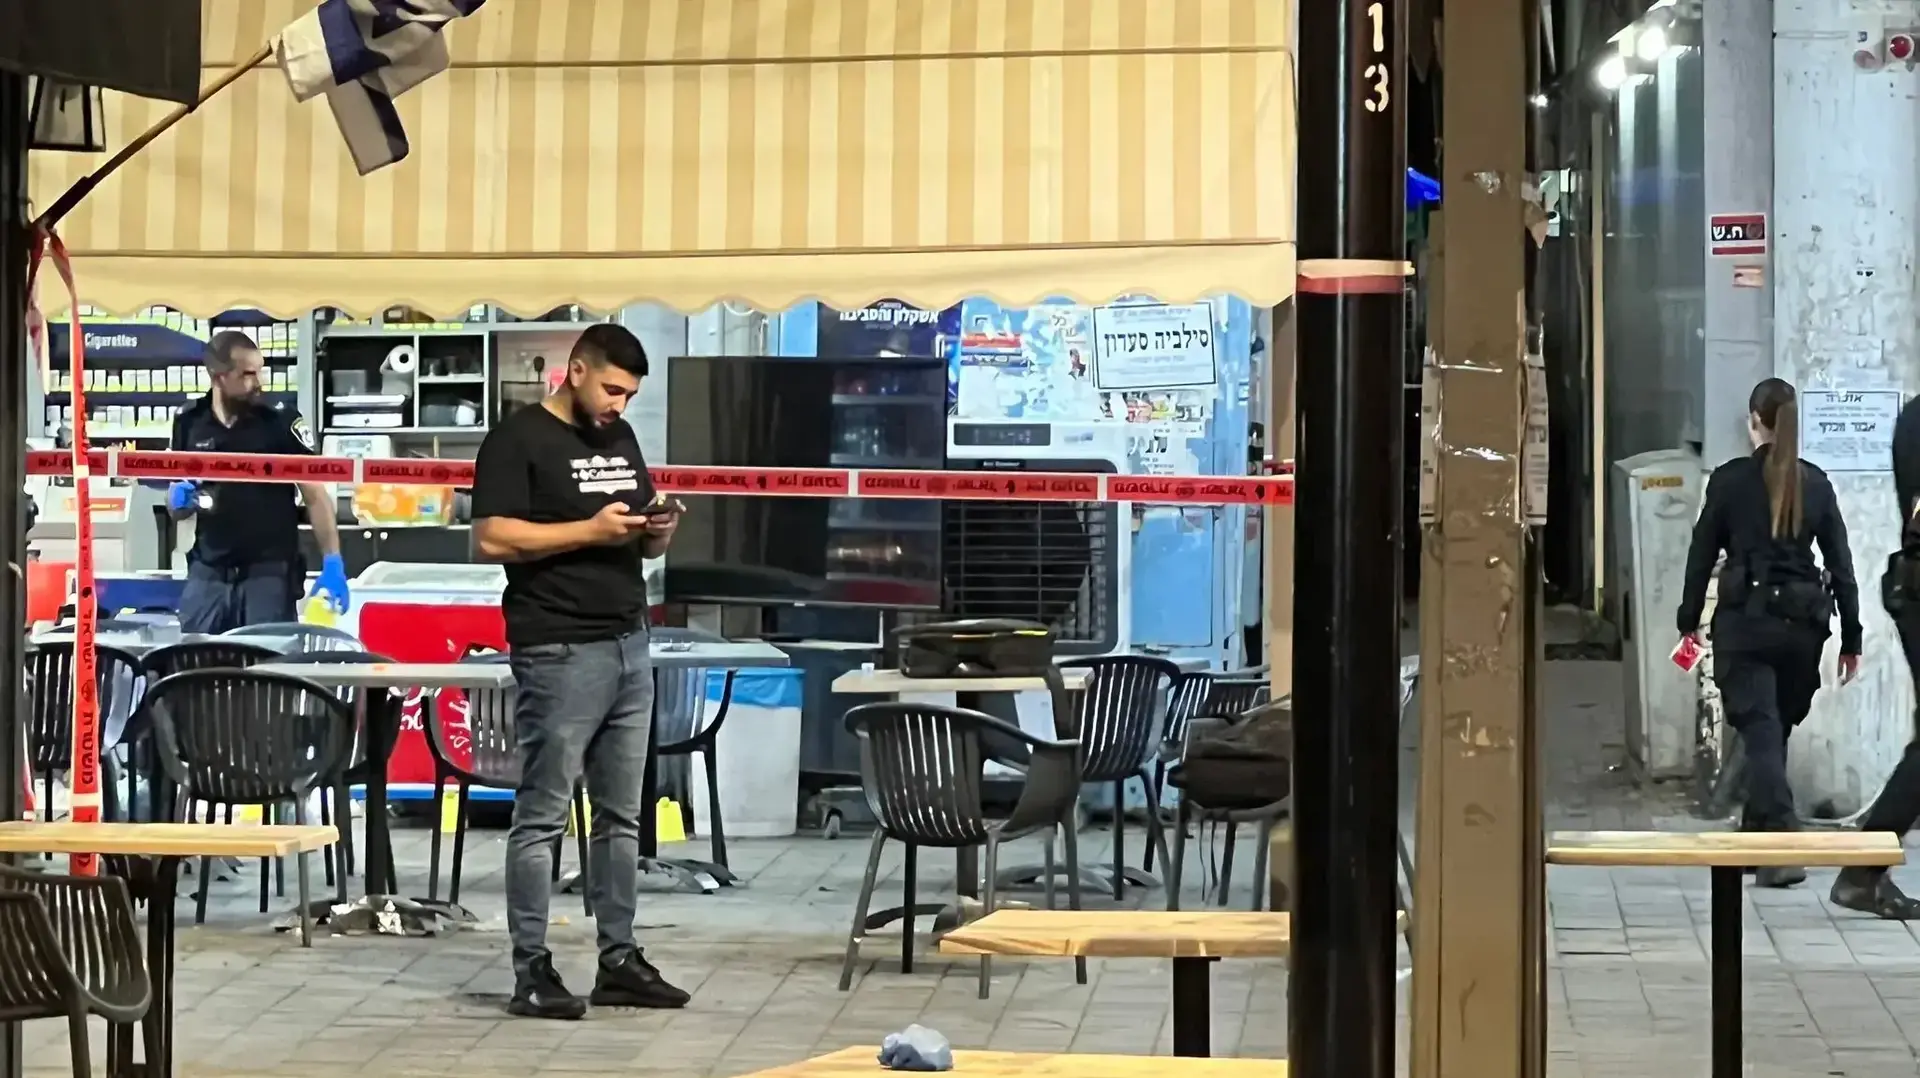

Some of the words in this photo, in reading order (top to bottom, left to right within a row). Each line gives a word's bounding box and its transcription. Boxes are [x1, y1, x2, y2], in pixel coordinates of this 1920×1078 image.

[84, 332, 138, 350] Cigarettes
[1103, 332, 1149, 358] סעדון
[1154, 321, 1209, 349] סילביה
[81, 711, 94, 784] משטרת
